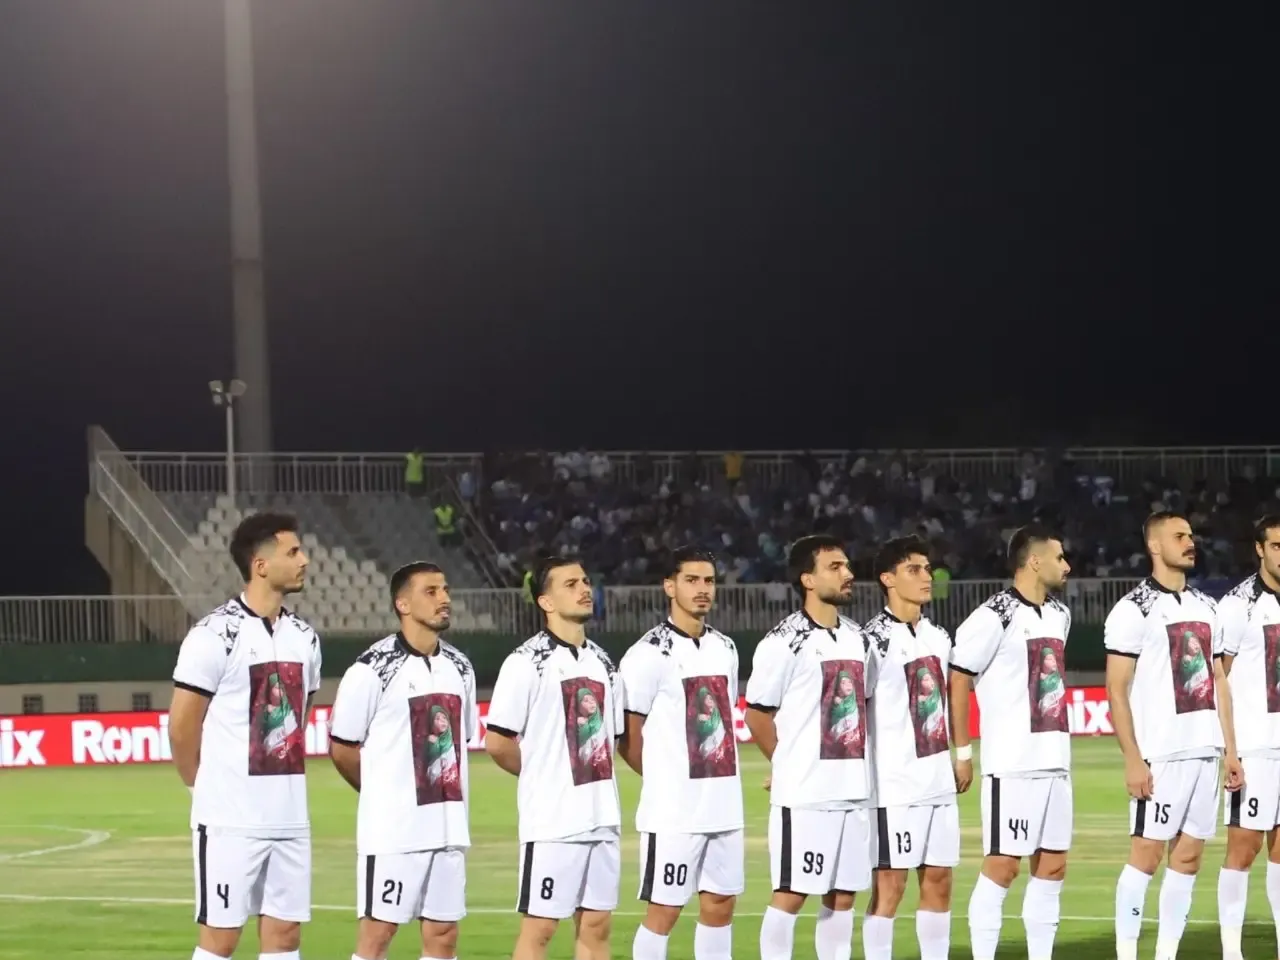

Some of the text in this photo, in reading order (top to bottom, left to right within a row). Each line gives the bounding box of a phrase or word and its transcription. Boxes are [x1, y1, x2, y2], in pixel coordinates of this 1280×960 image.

[71, 714, 173, 764] Roni
[1154, 802, 1172, 825] 15
[1247, 797, 1259, 818] 9
[1008, 817, 1029, 841] 44
[895, 831, 912, 855] 13
[663, 862, 688, 887] 80
[802, 851, 825, 876] 99
[216, 883, 230, 909] 4
[381, 879, 404, 906] 21
[540, 877, 555, 900] 8
